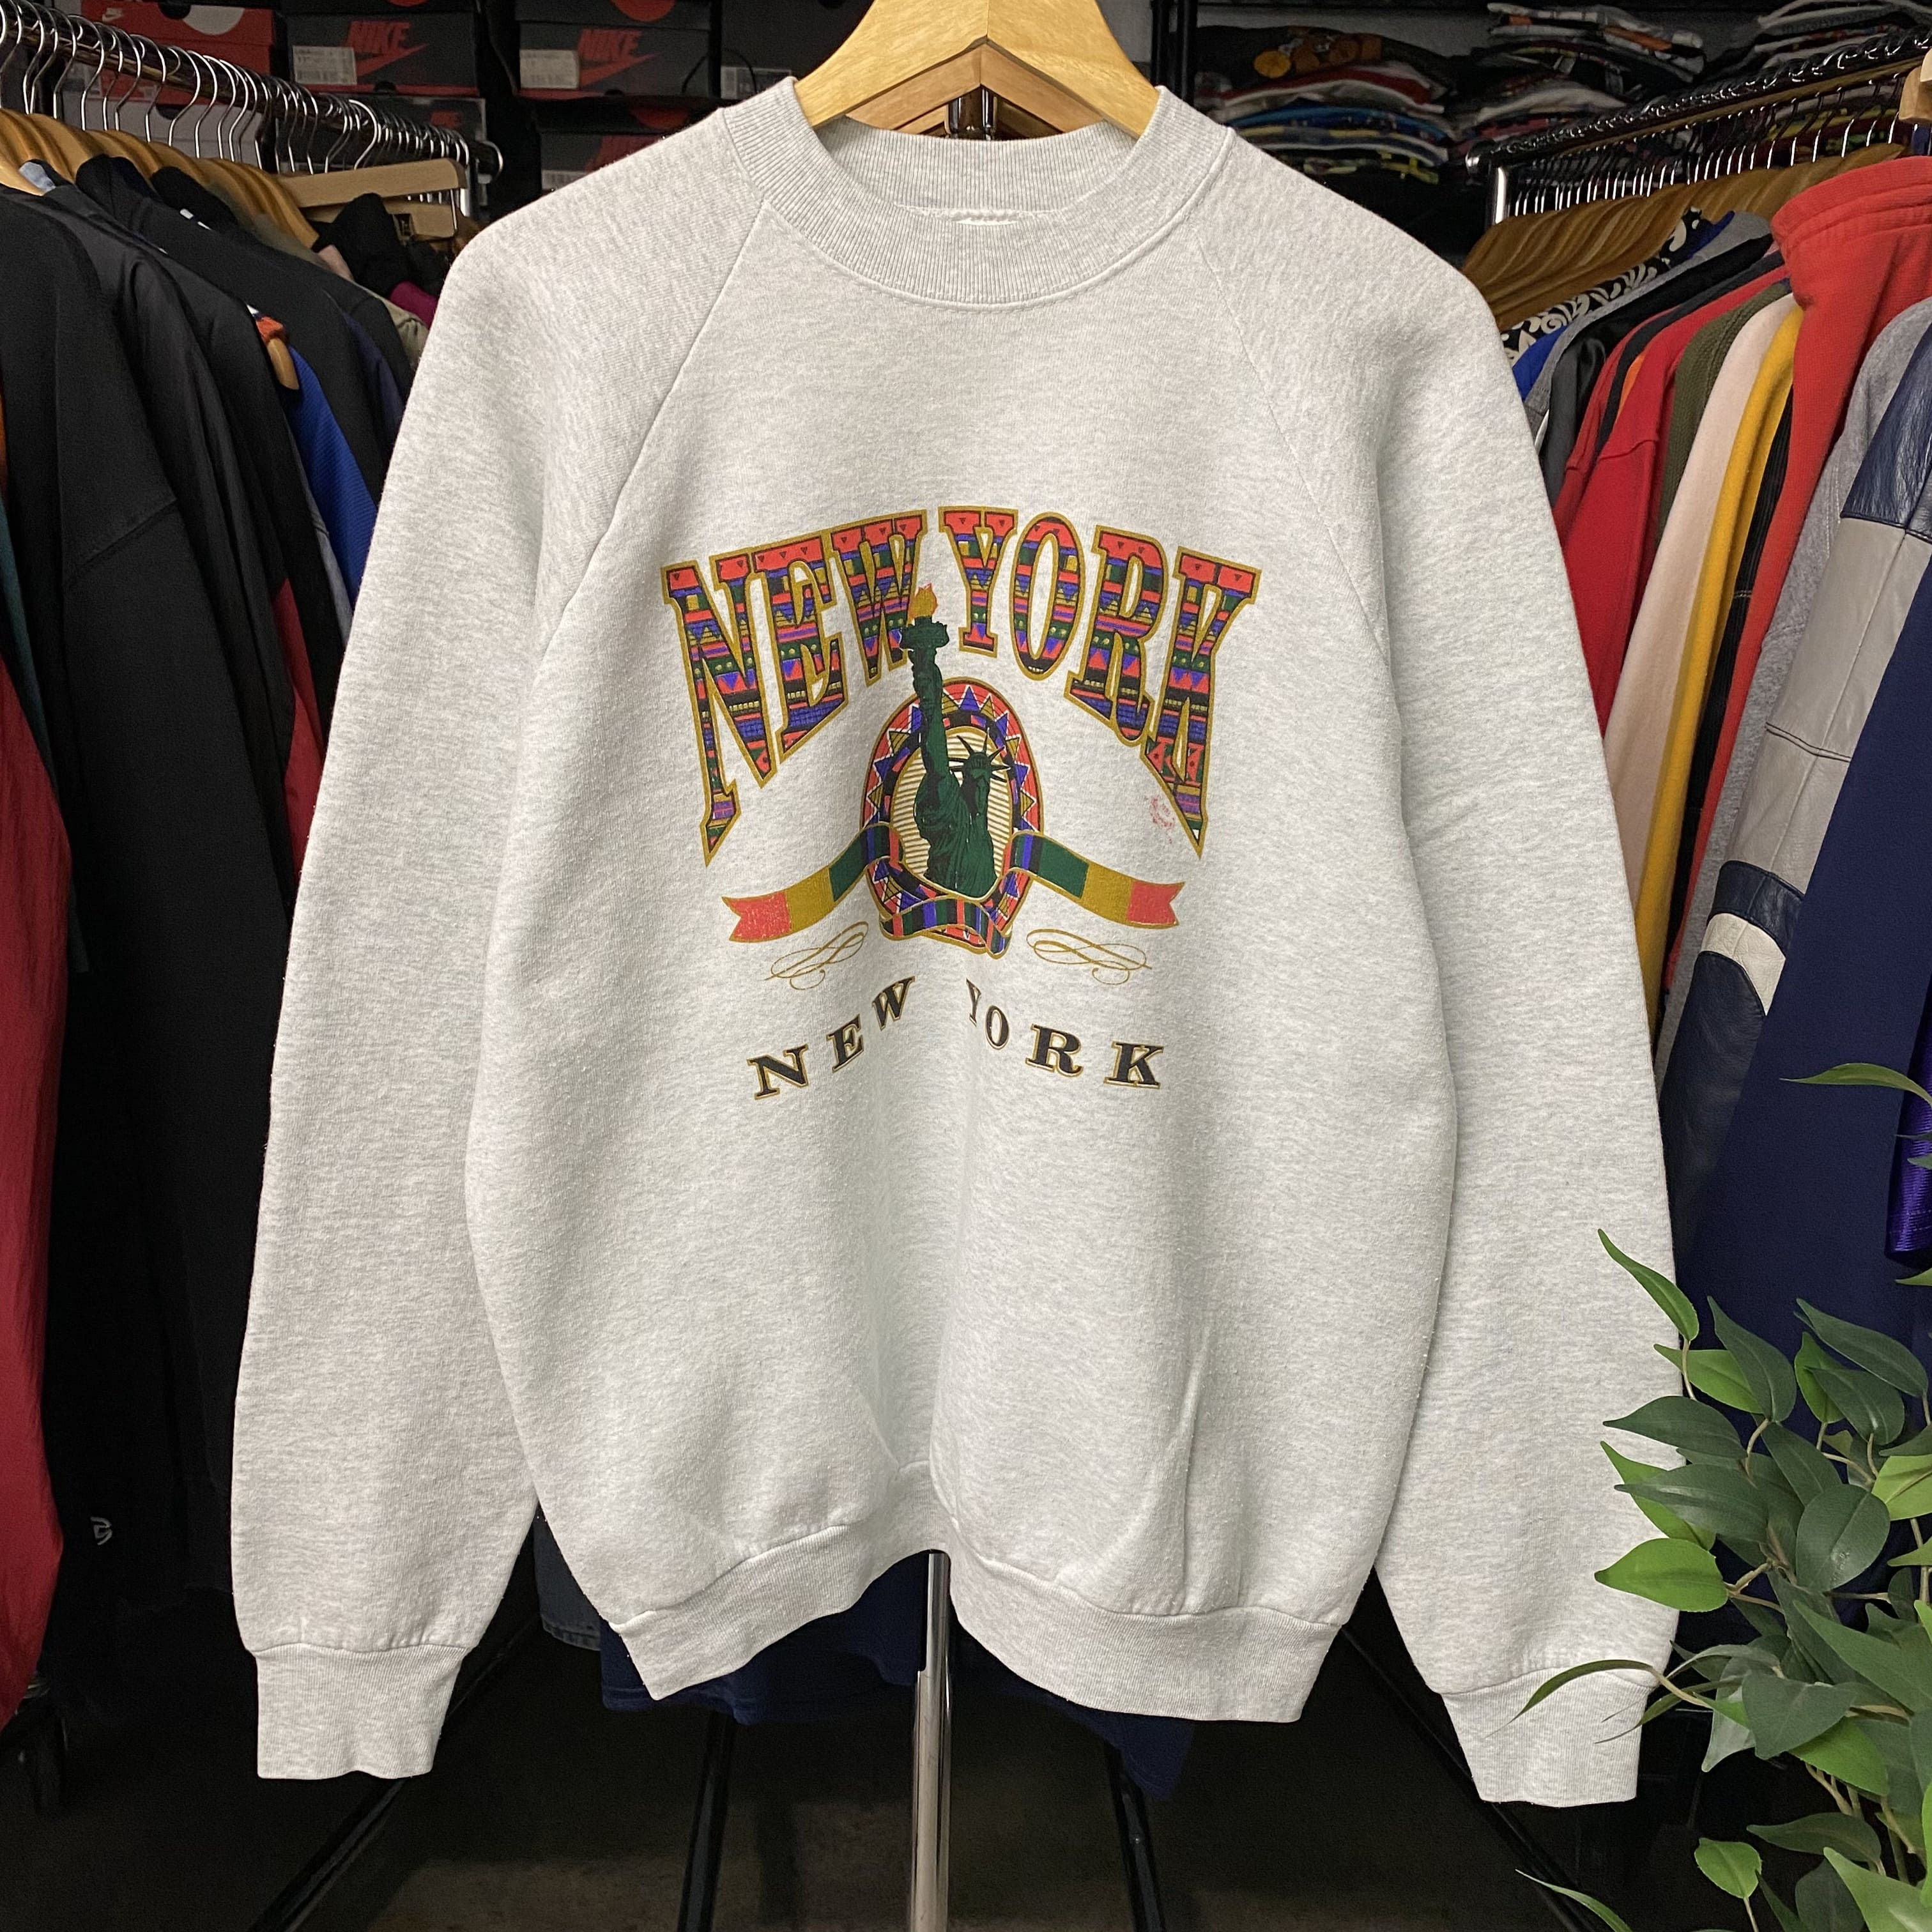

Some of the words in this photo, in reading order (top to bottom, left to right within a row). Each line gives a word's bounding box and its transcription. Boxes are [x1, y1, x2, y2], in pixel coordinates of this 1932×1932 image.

[346, 20, 411, 54] NIKE
[578, 28, 643, 61] NIKE
[661, 509, 927, 867] NEW
[938, 506, 1262, 859] YORK
[747, 976, 915, 1100] NEW
[966, 977, 1164, 1089] YORK
